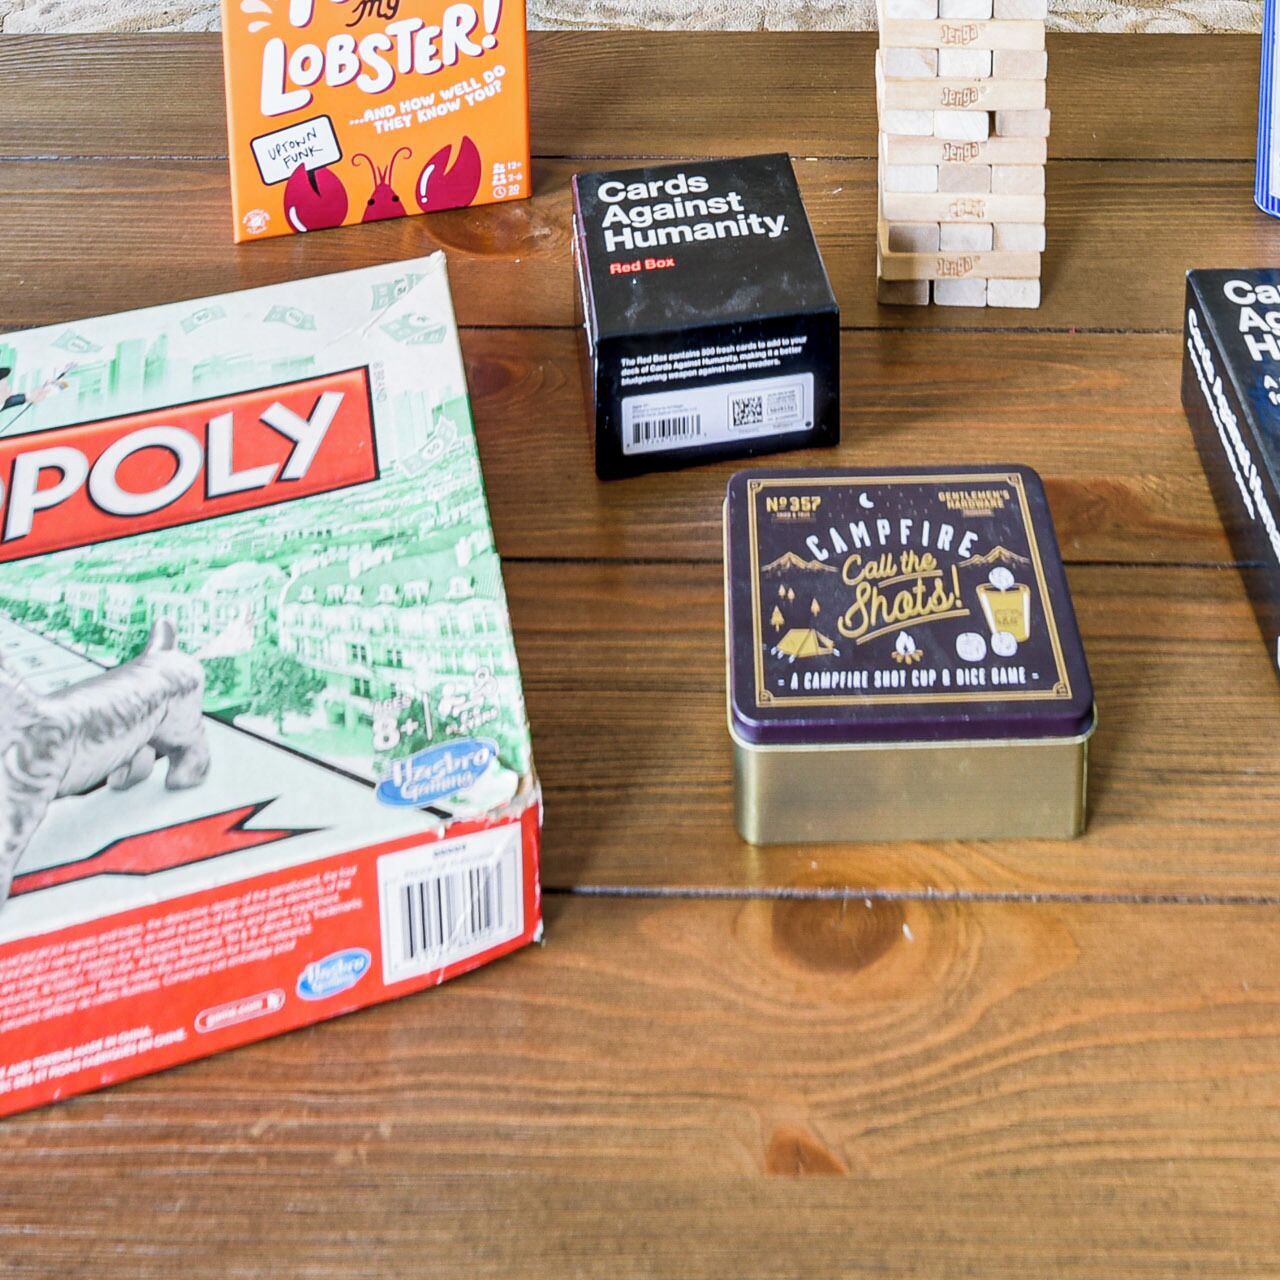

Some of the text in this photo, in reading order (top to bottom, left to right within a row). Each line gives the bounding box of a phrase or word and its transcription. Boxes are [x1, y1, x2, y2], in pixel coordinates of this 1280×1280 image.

[941, 24, 979, 45] Jenga
[348, 64, 506, 126] ...AND HOW WELL DO
[373, 79, 502, 135] THEY KNOW YOU?
[941, 87, 979, 107] Jenga
[268, 127, 319, 160] UPTOWN
[283, 146, 324, 170] FUNK
[943, 142, 980, 162] Jenga
[597, 173, 709, 203] Cards
[601, 191, 744, 228] Against
[604, 213, 789, 252] Humanity.
[610, 257, 675, 275] Red Box
[1264, 375, 1279, 390] A
[789, 496, 821, 512] 357
[938, 490, 1010, 502] GENTLEMEN'S
[947, 499, 1004, 509] HARDWARE
[806, 518, 979, 562] CAMPFIRE
[841, 549, 938, 585] Call the
[837, 564, 962, 639] Shots!
[790, 672, 799, 690] A
[804, 670, 868, 689] CAMPFIRE
[874, 669, 906, 688] SHOT
[911, 669, 937, 688] CUP
[956, 667, 986, 686] DICE
[991, 666, 1026, 685] GAME
[373, 718, 420, 751] 8+
[392, 747, 490, 787] Hasbro
[400, 771, 475, 802] Gaming
[307, 956, 366, 983] Hasbro
